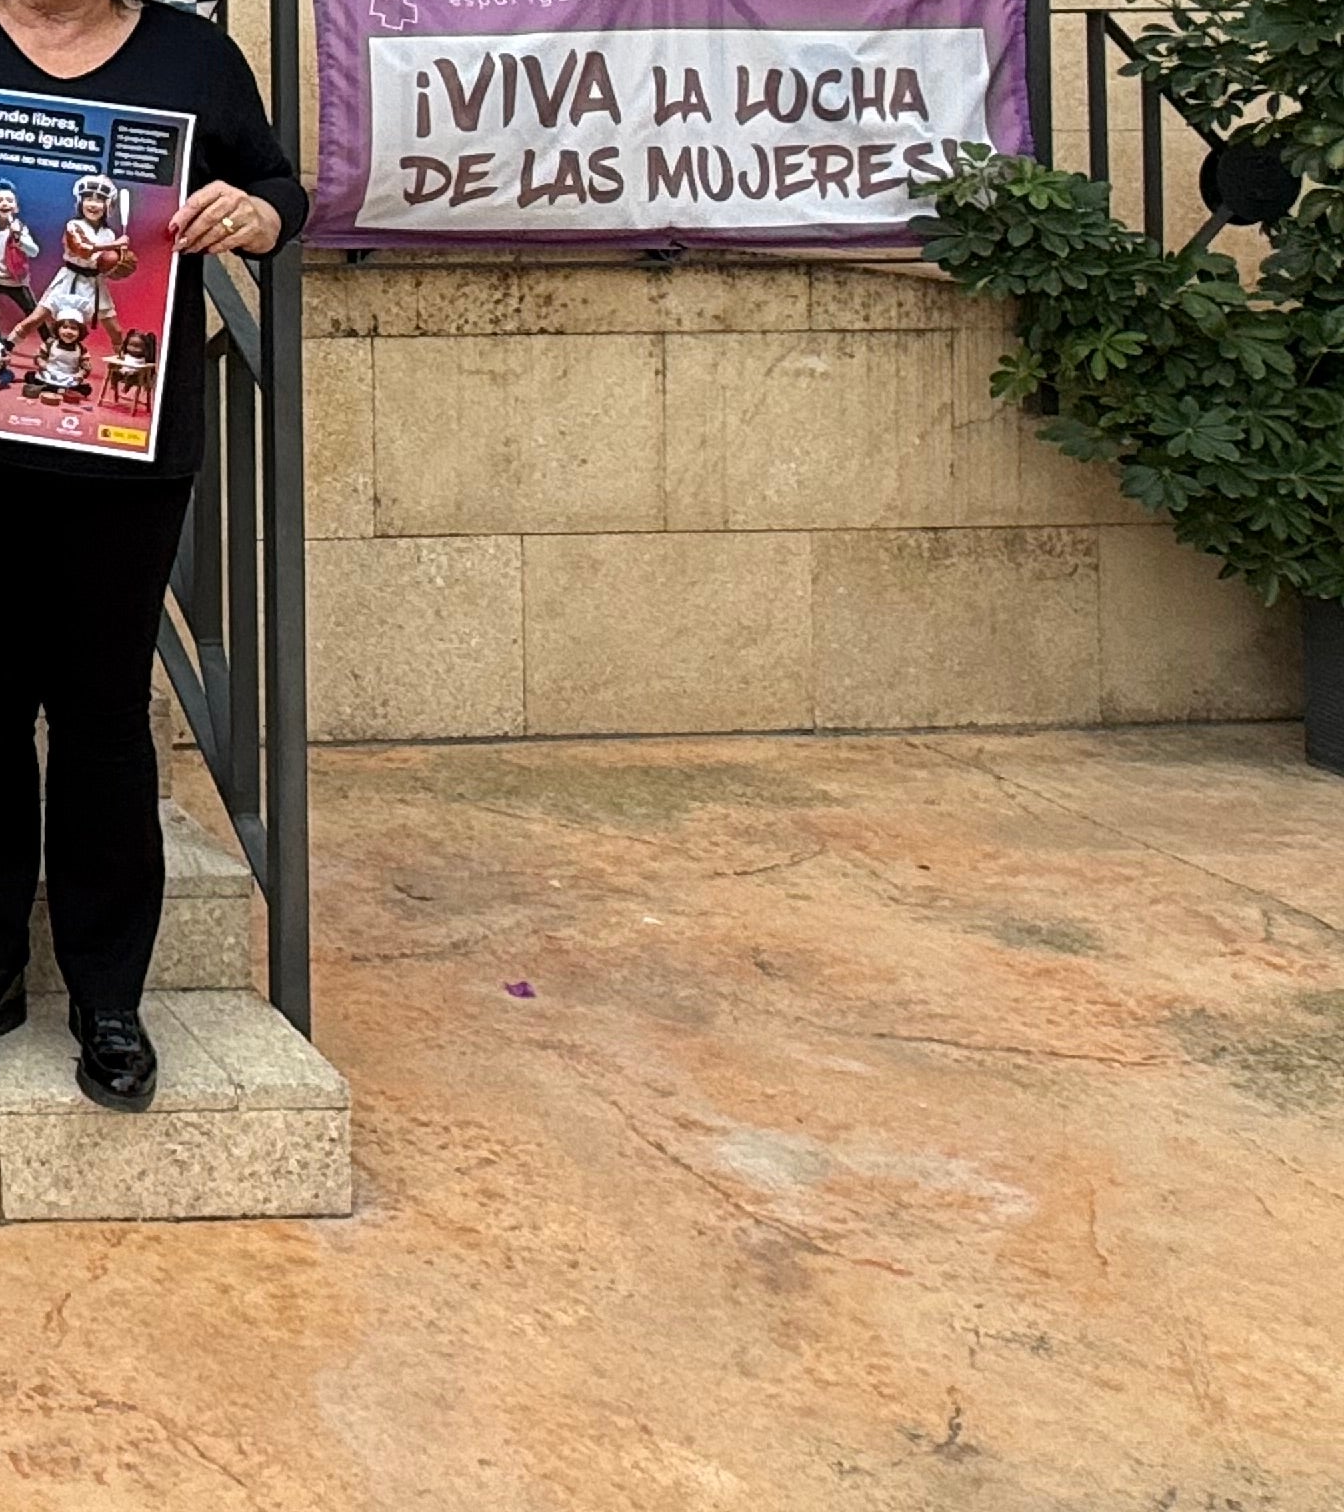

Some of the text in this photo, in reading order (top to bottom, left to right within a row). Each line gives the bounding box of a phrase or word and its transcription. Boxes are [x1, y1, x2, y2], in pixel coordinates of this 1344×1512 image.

[416, 48, 930, 139] ¡VIVA LA LUCHA
[32, 112, 80, 133] libres,
[38, 130, 101, 152] iguales.
[399, 152, 495, 208] DE
[515, 144, 625, 209] LAS
